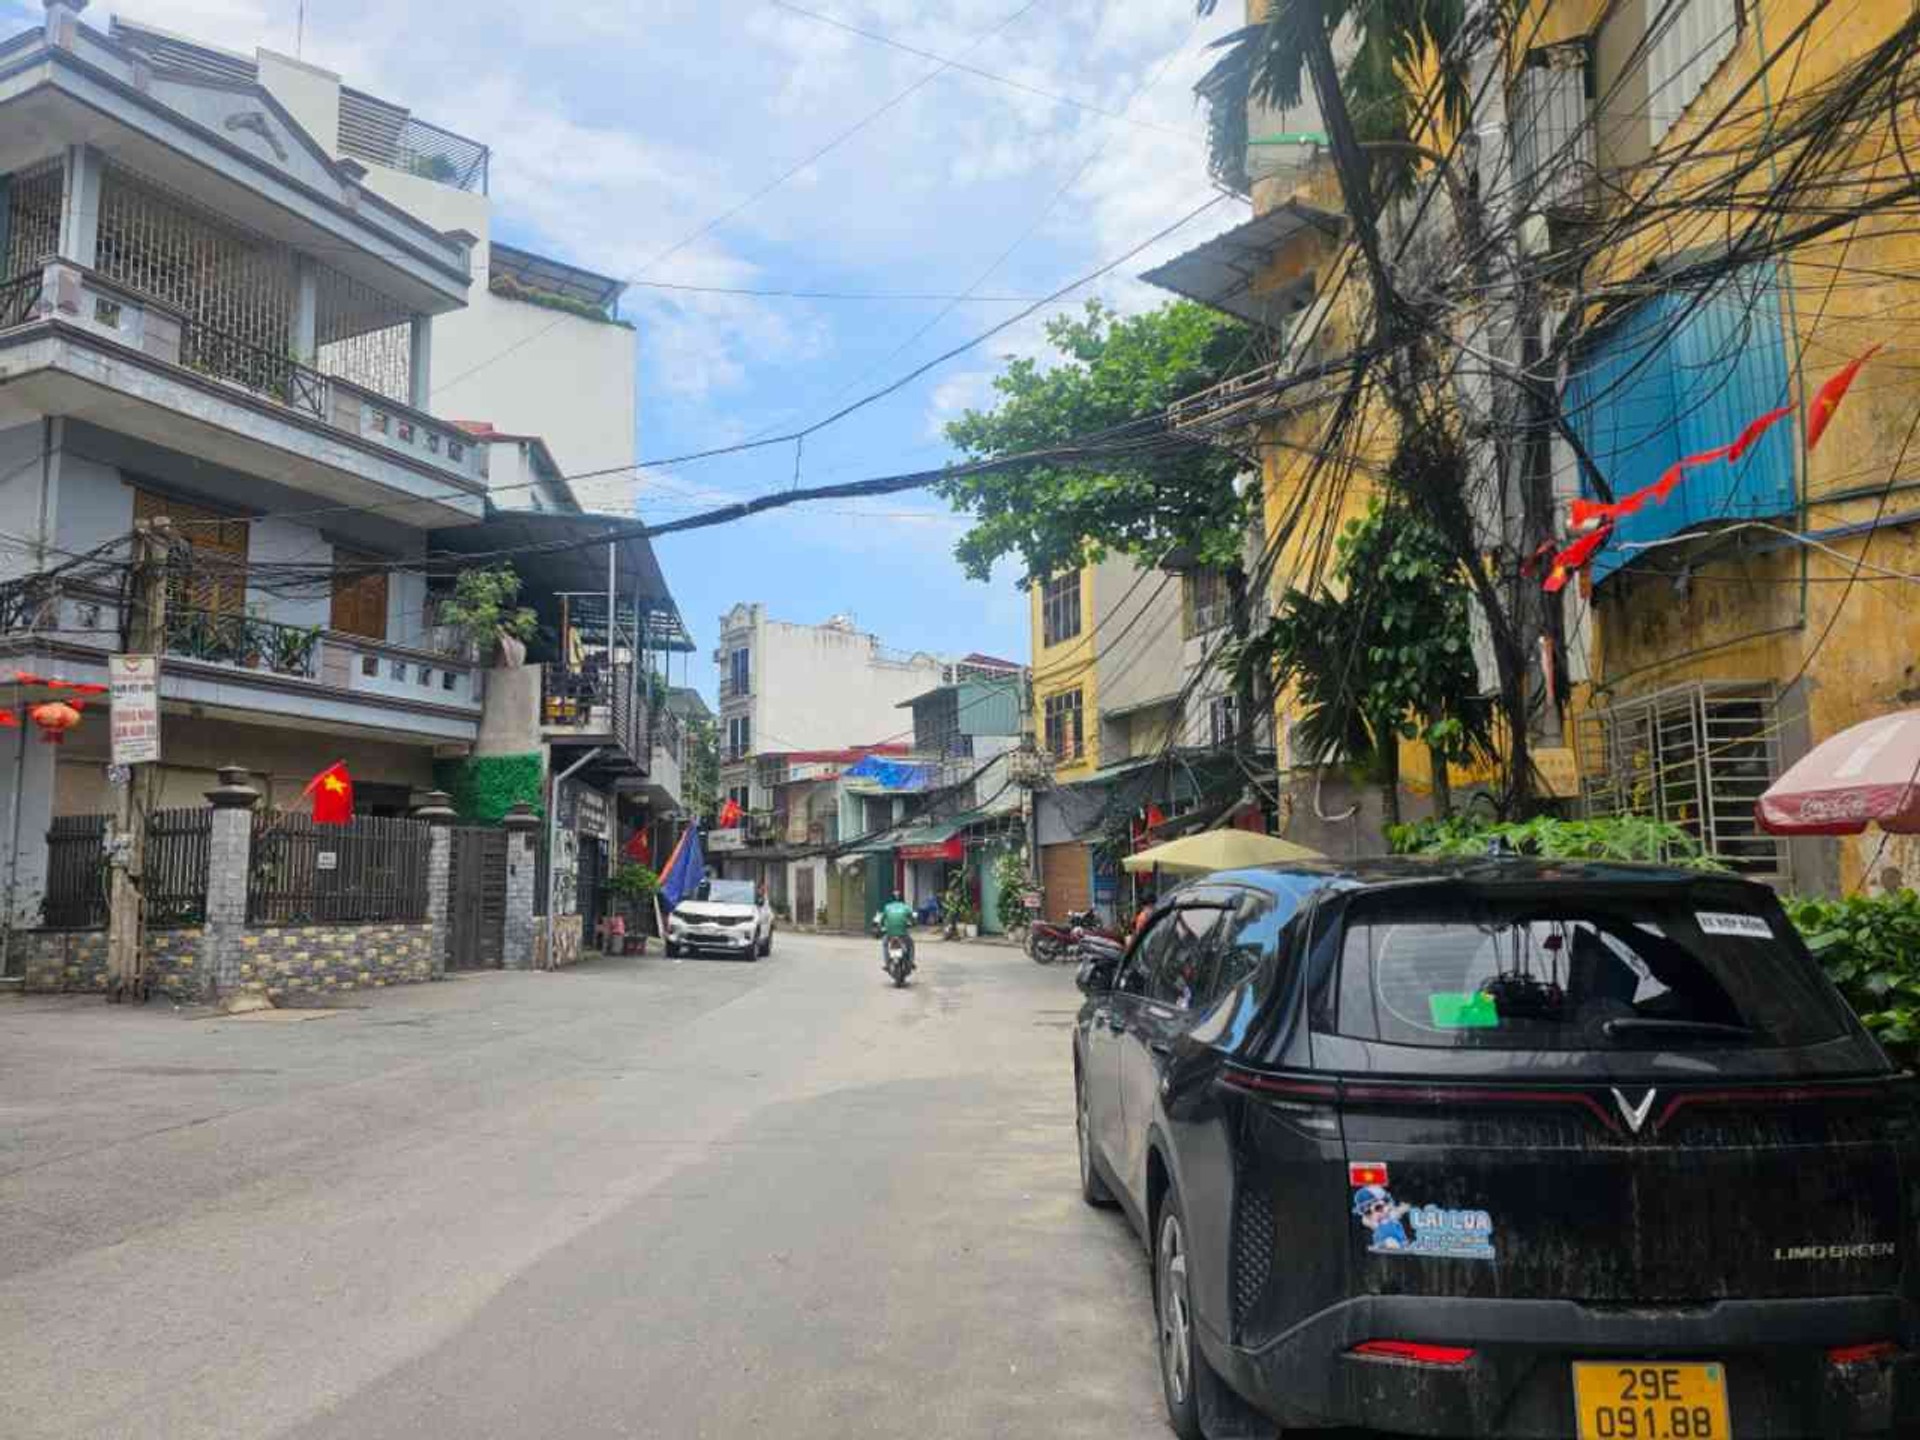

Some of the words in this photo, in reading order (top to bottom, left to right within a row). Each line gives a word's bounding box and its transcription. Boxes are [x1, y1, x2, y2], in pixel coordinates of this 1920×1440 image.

[1776, 1247, 1825, 1259] LIMO
[1829, 1242, 1895, 1258] GREEN
[1618, 1368, 1681, 1401] 29E
[1596, 1406, 1712, 1438] 091.88
